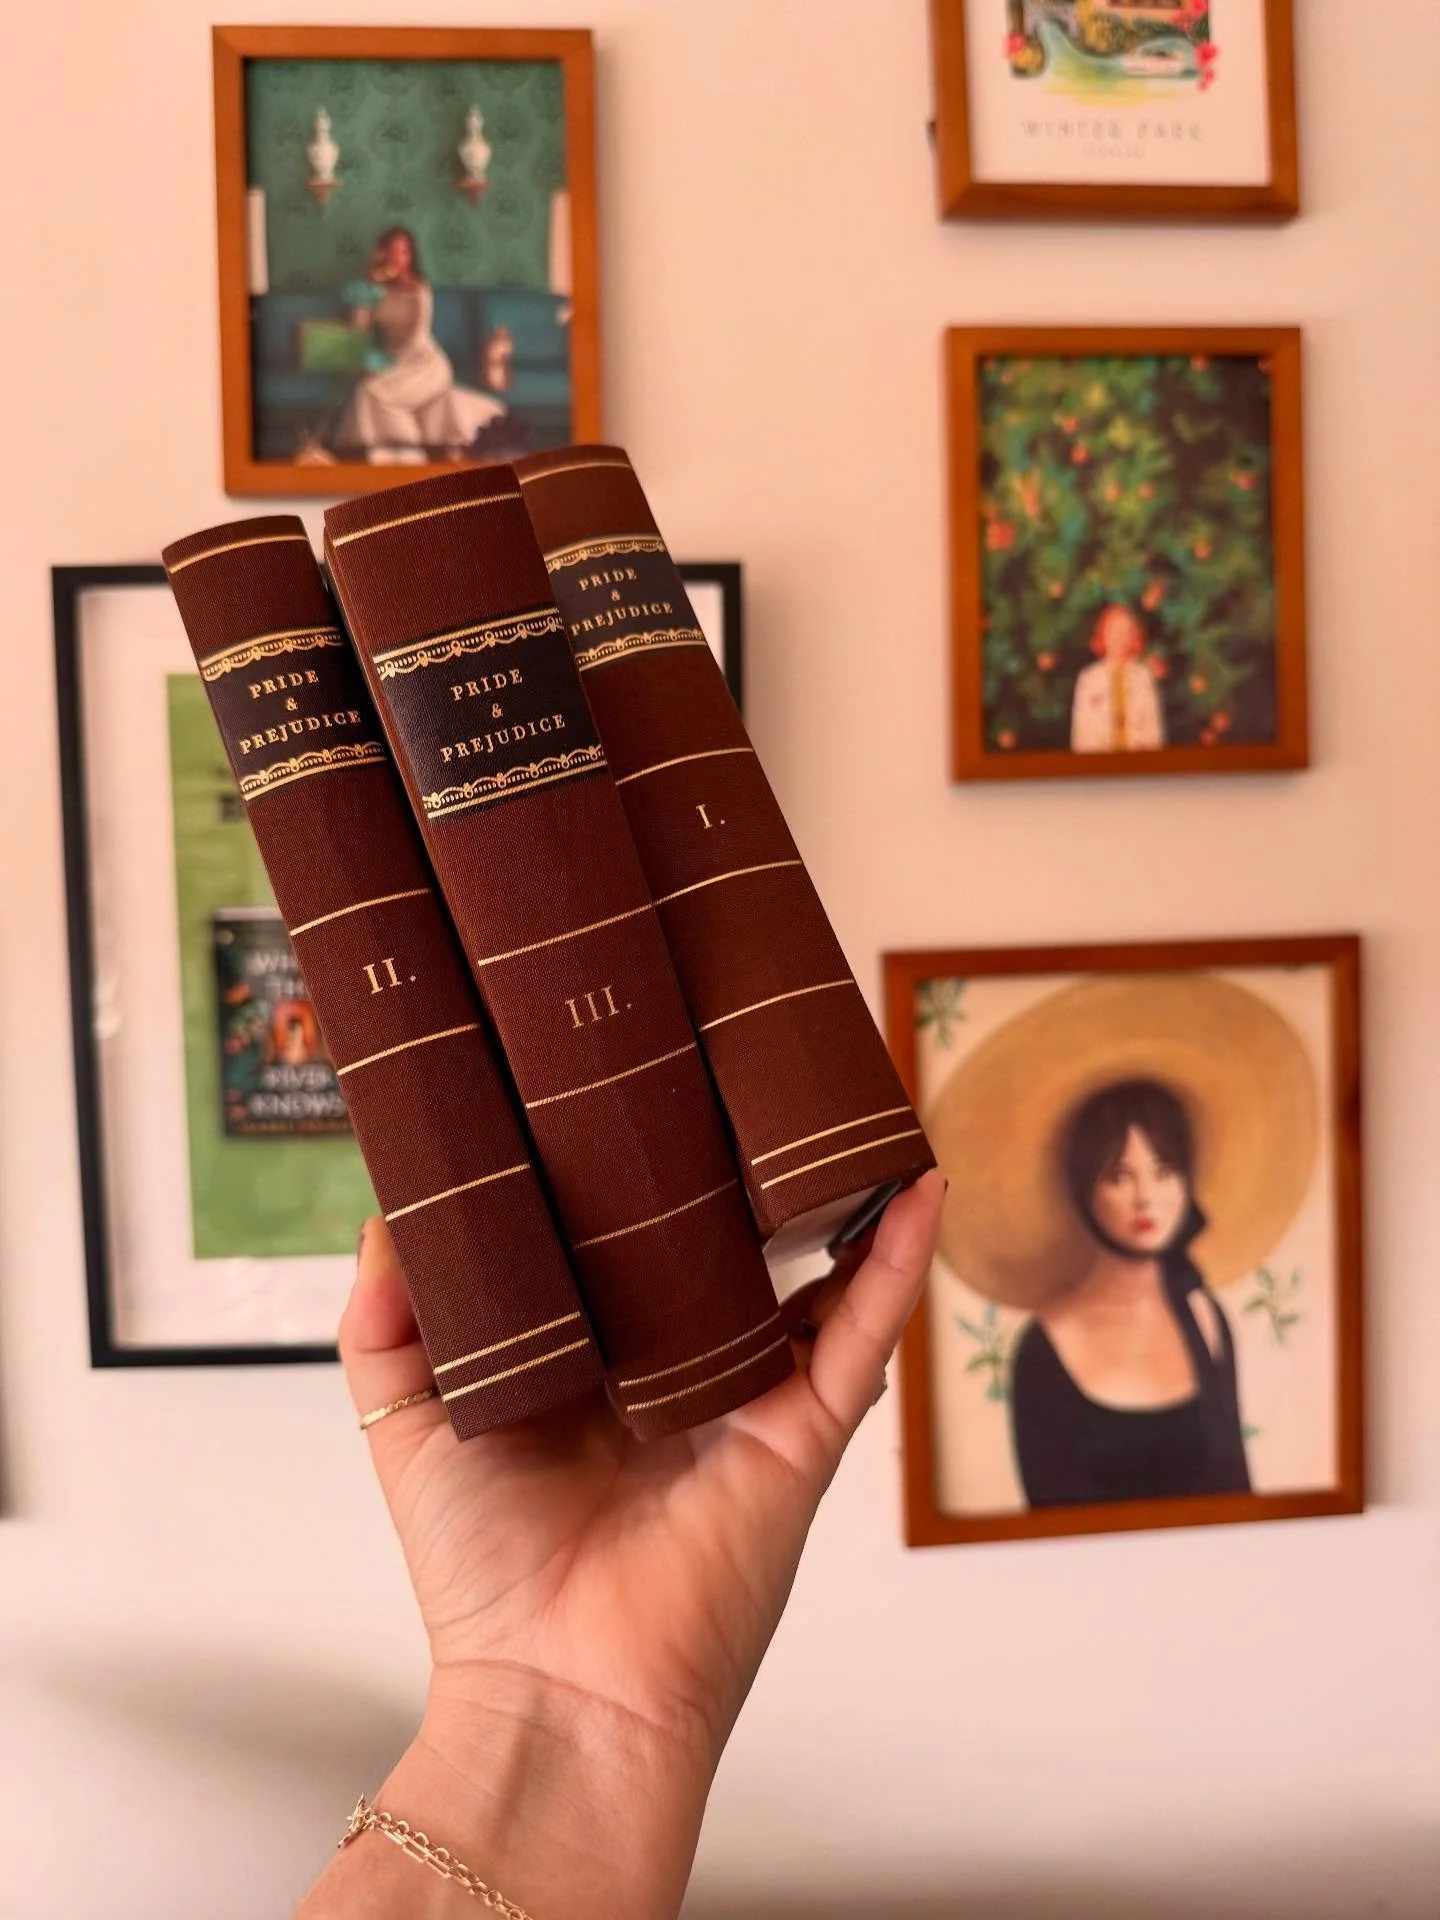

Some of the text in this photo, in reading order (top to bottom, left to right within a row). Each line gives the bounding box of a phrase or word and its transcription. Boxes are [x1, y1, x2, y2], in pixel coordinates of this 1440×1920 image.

[579, 567, 638, 592] PRIDE
[611, 589, 621, 602] &
[571, 601, 673, 637] PREJUDICE
[248, 669, 319, 700] PRIDE
[450, 668, 523, 702] PRIDE
[286, 697, 299, 712] &
[491, 702, 504, 719] &
[240, 710, 361, 755] PREJUDICE
[440, 713, 566, 763] PREJUDICE
[695, 803, 726, 830] I.
[363, 957, 417, 995] II.
[564, 984, 633, 1029] III.
